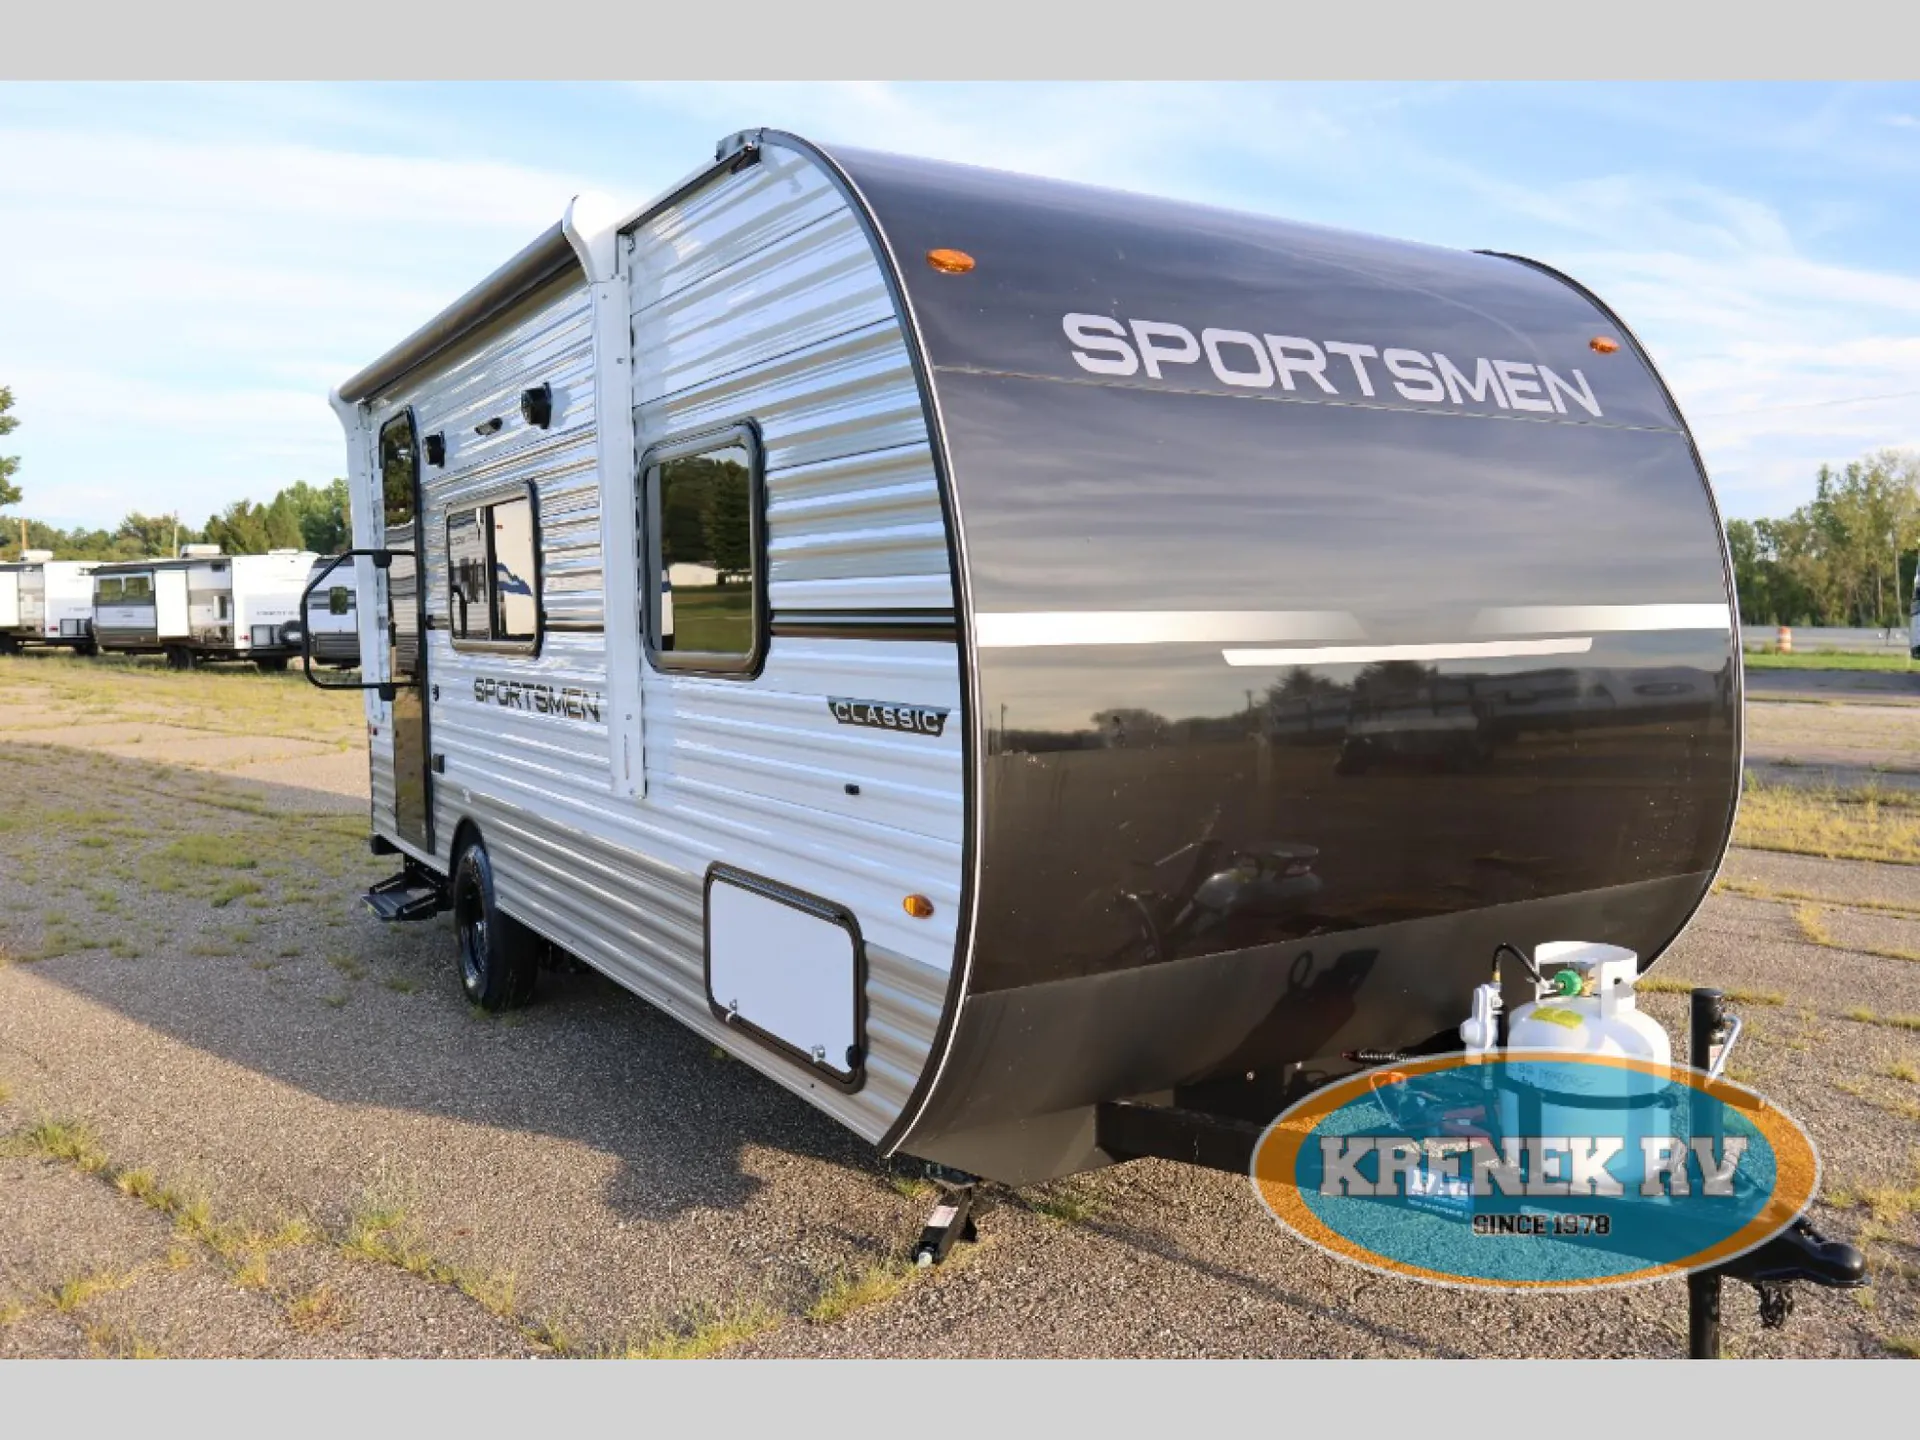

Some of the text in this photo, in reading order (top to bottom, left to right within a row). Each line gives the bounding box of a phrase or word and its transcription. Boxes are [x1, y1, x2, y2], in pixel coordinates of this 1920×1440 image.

[1063, 312, 1603, 417] SPORTSMEN
[474, 677, 601, 722] SPORTSMEN
[835, 701, 939, 732] CLASSIC
